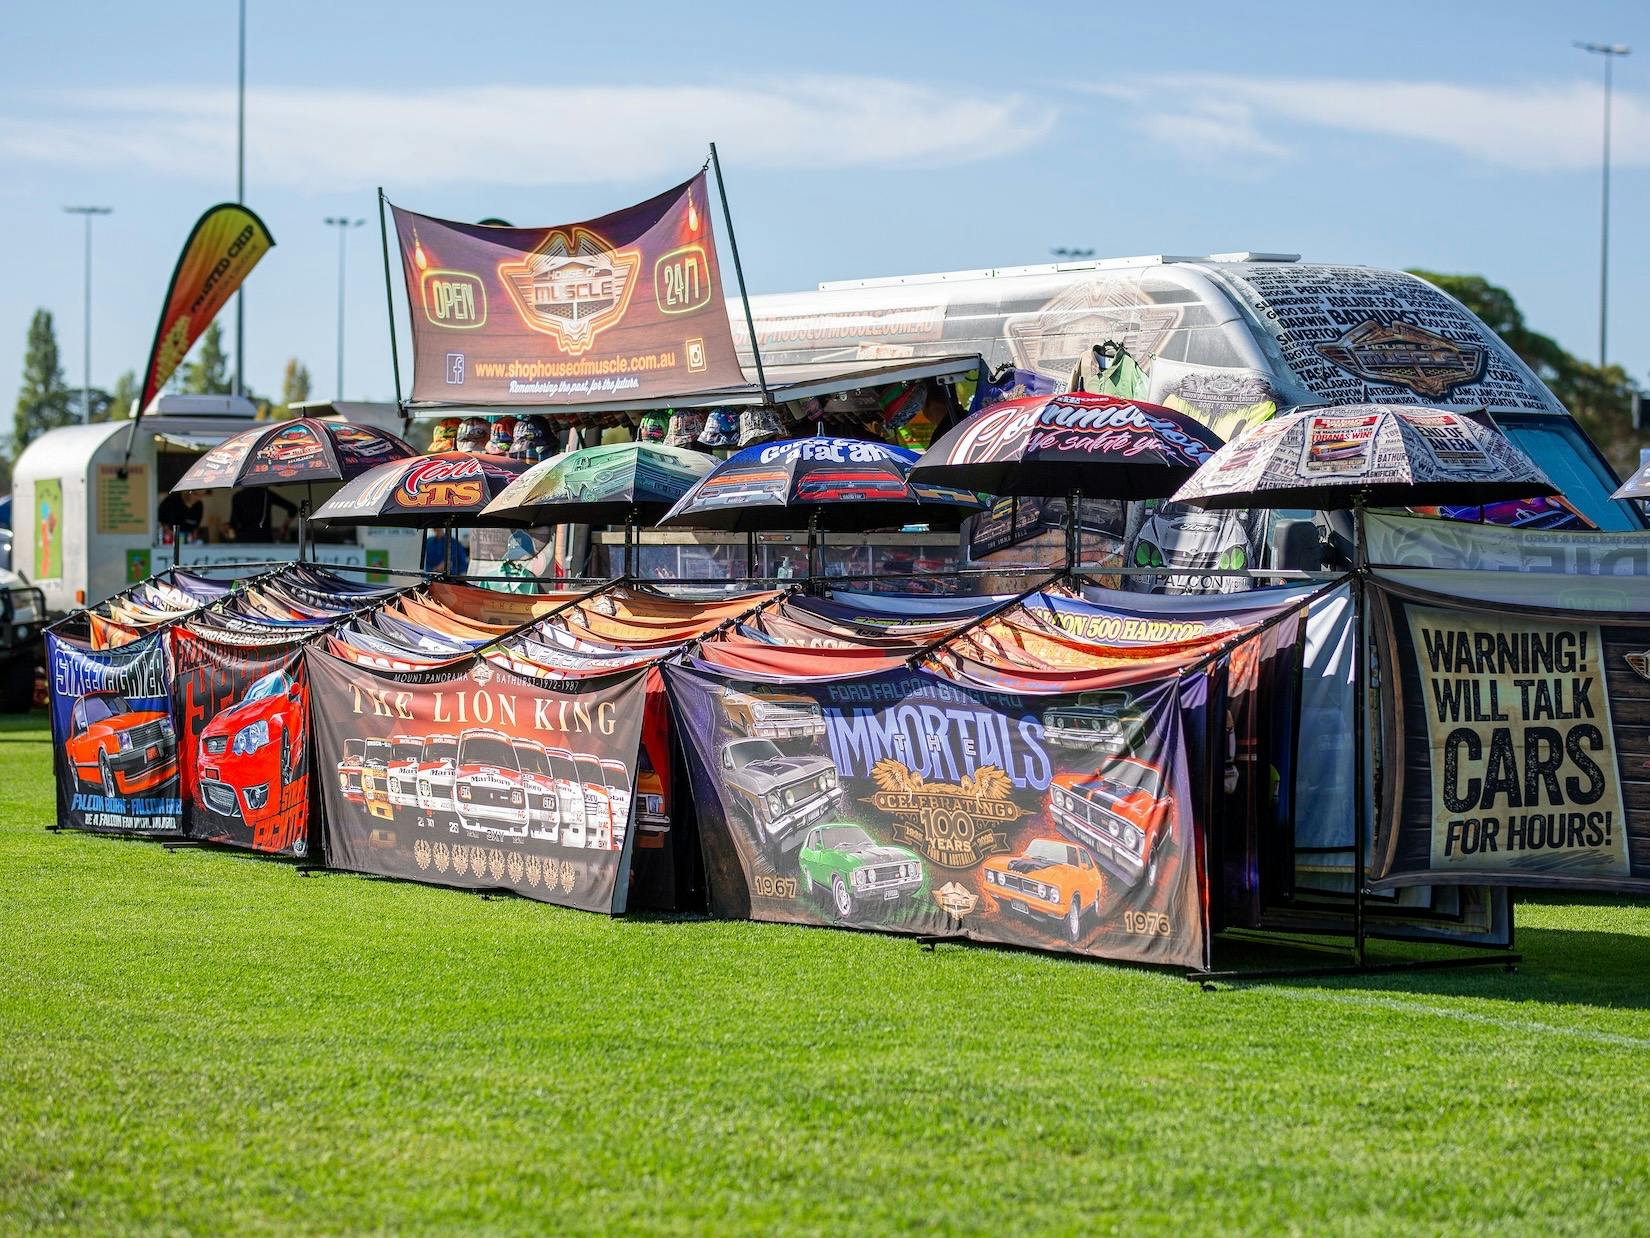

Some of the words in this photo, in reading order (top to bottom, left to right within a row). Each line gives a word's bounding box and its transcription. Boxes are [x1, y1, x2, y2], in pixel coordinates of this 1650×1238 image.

[227, 224, 254, 258] CHIP
[664, 257, 699, 305] 24/7
[1294, 285, 1337, 294] PERTH
[432, 280, 476, 320] OPEN
[1326, 296, 1378, 308] ADELAIDE
[1277, 316, 1332, 330] DARWIN
[1326, 309, 1424, 329] BATHURST
[1275, 327, 1343, 347] SILVERTON
[475, 352, 676, 381] www.shophouseofmuscle.com.au
[1282, 348, 1315, 362] ARGYLE
[1288, 357, 1322, 371] DUBBO
[1296, 365, 1344, 383] TASSIE
[509, 379, 558, 397] Remembering
[558, 379, 569, 392] the
[587, 379, 602, 395] for
[601, 378, 614, 390] the
[612, 376, 639, 393] future.
[1414, 426, 1447, 438] END
[1443, 427, 1466, 439] OF
[1426, 437, 1453, 451] AN
[1446, 438, 1480, 451] ERA
[395, 480, 482, 507] GTS
[1086, 615, 1121, 642] 500
[1120, 618, 1206, 643] HARDTOP
[1422, 628, 1589, 675] WARNING!
[393, 672, 423, 682] MOUNT
[425, 672, 468, 684] PANORAMA
[829, 685, 871, 701] FORD
[872, 677, 937, 701] FALCON
[348, 682, 415, 720] THE
[432, 689, 518, 727] LION
[534, 698, 617, 736] KING
[1431, 678, 1509, 723] WILL
[1513, 678, 1595, 721] TALK
[821, 704, 1053, 791] IMMORTALS
[894, 733, 977, 757] THE
[1442, 723, 1606, 814] CARS
[886, 794, 1007, 818] CELEBRATING
[920, 807, 976, 841] 100
[1444, 817, 1500, 857] FOR
[1506, 811, 1613, 851] HOURS!
[928, 837, 972, 853] YEARS
[754, 875, 797, 899] 1967
[1123, 911, 1172, 937] 1976
